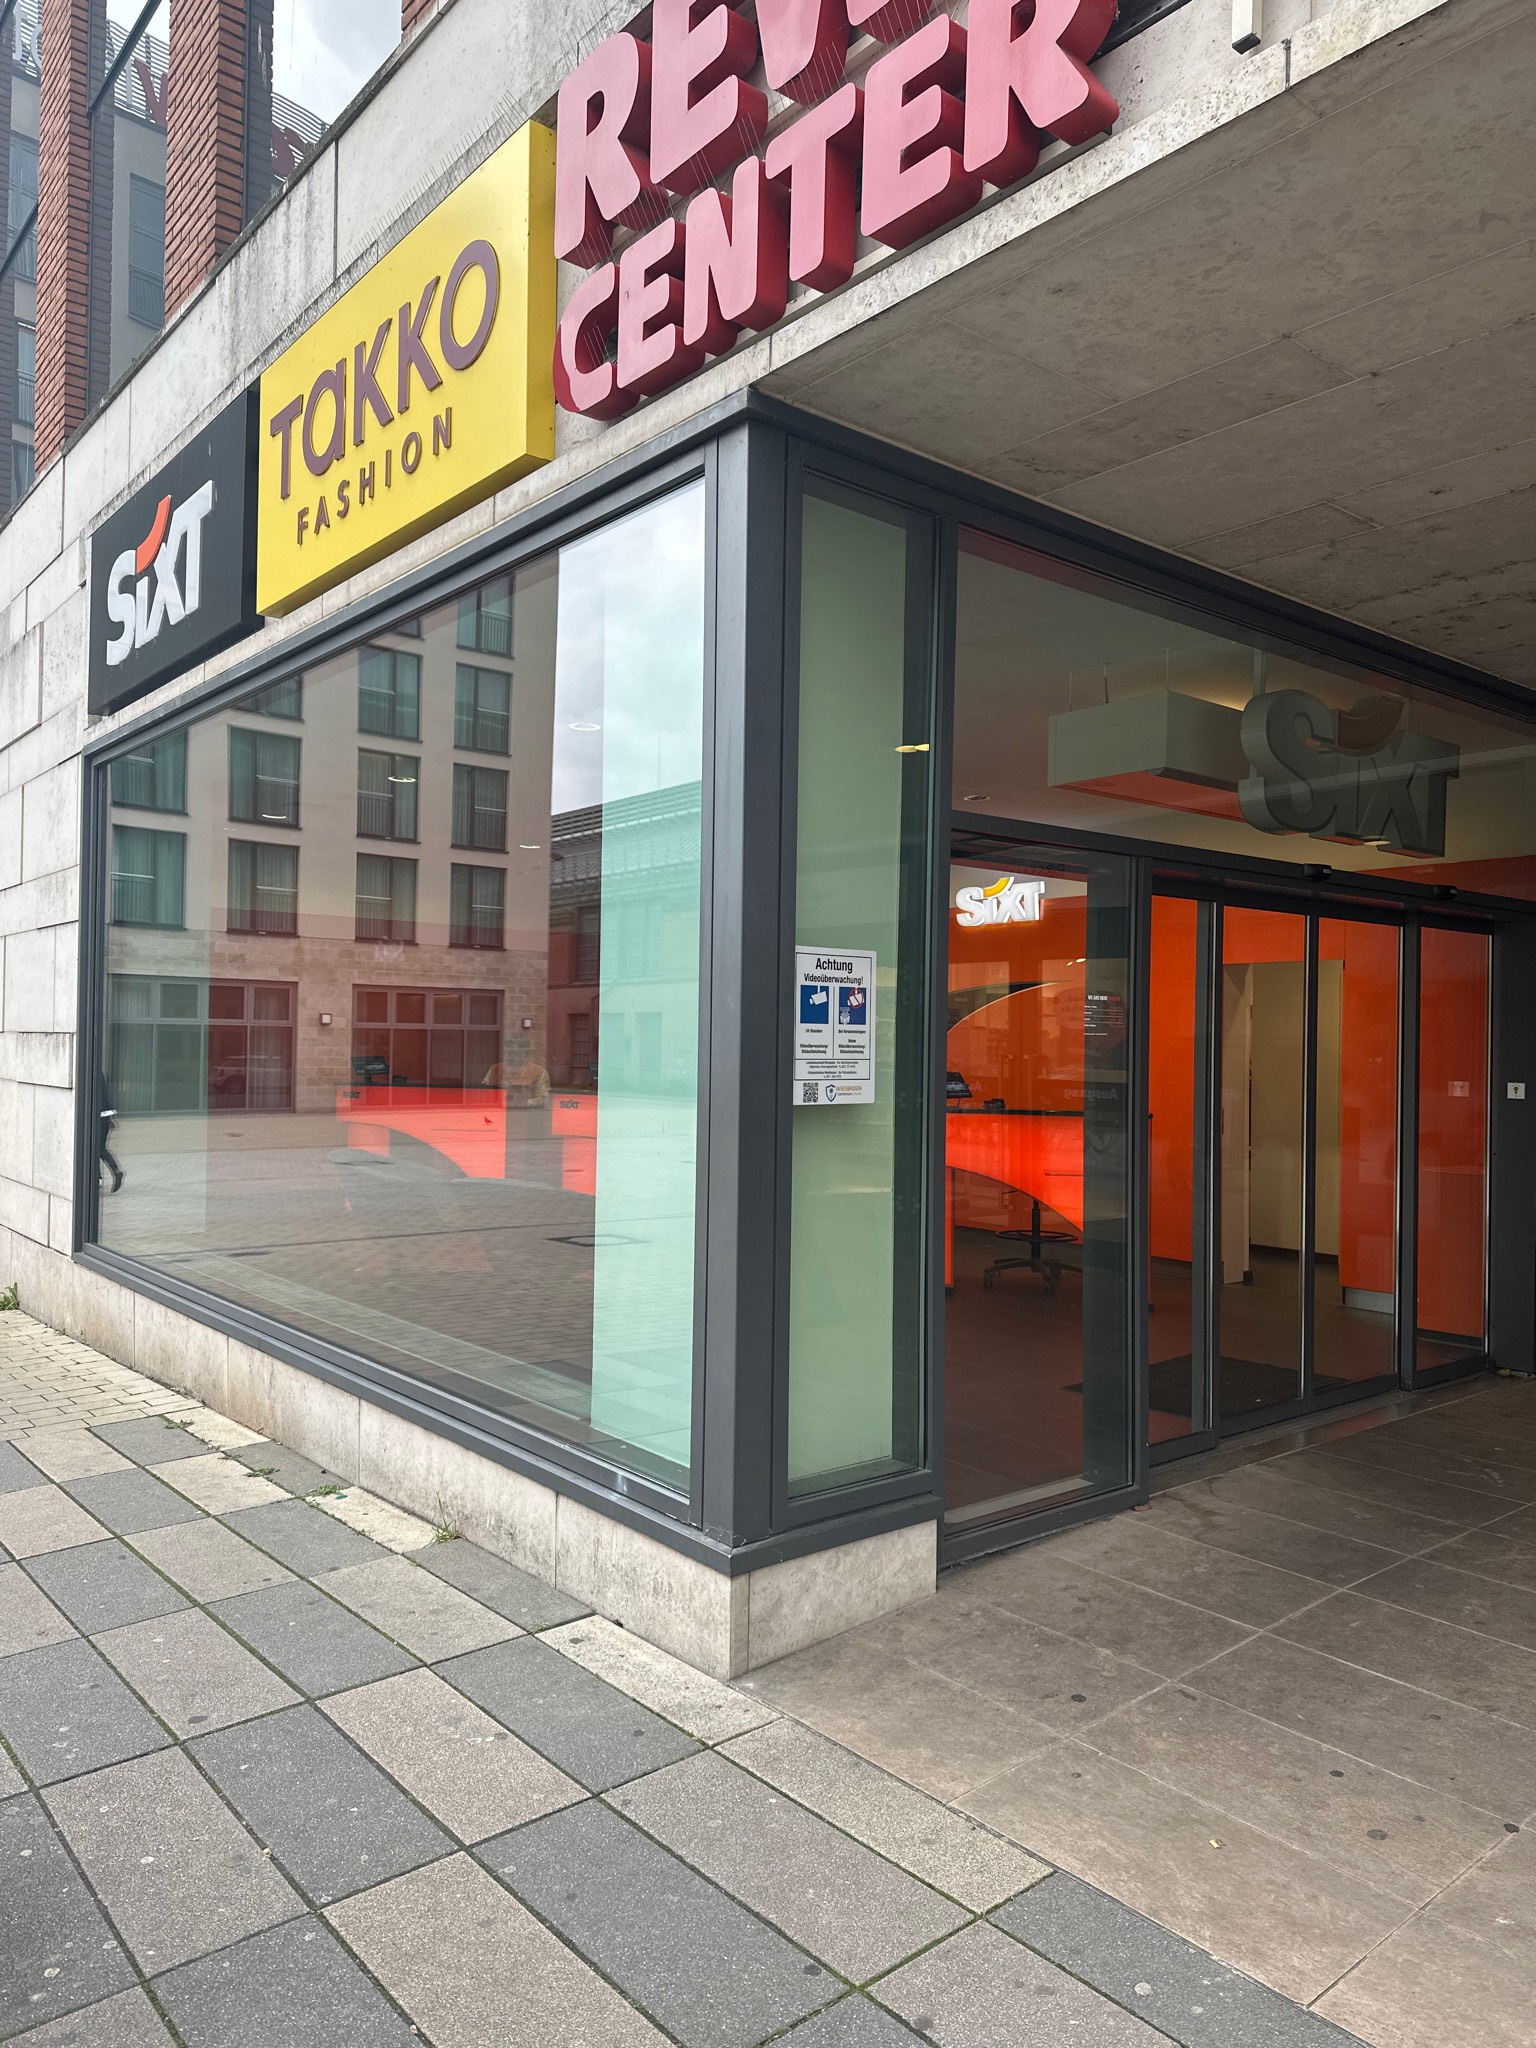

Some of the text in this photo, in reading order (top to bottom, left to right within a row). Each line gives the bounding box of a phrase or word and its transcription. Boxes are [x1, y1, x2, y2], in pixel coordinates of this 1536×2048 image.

[554, 0, 893, 260] RE
[554, 0, 1110, 415] CENTER
[296, 407, 452, 545] FASHION
[803, 973, 864, 986] Videoüberwachung!
[815, 957, 853, 974] Achtung
